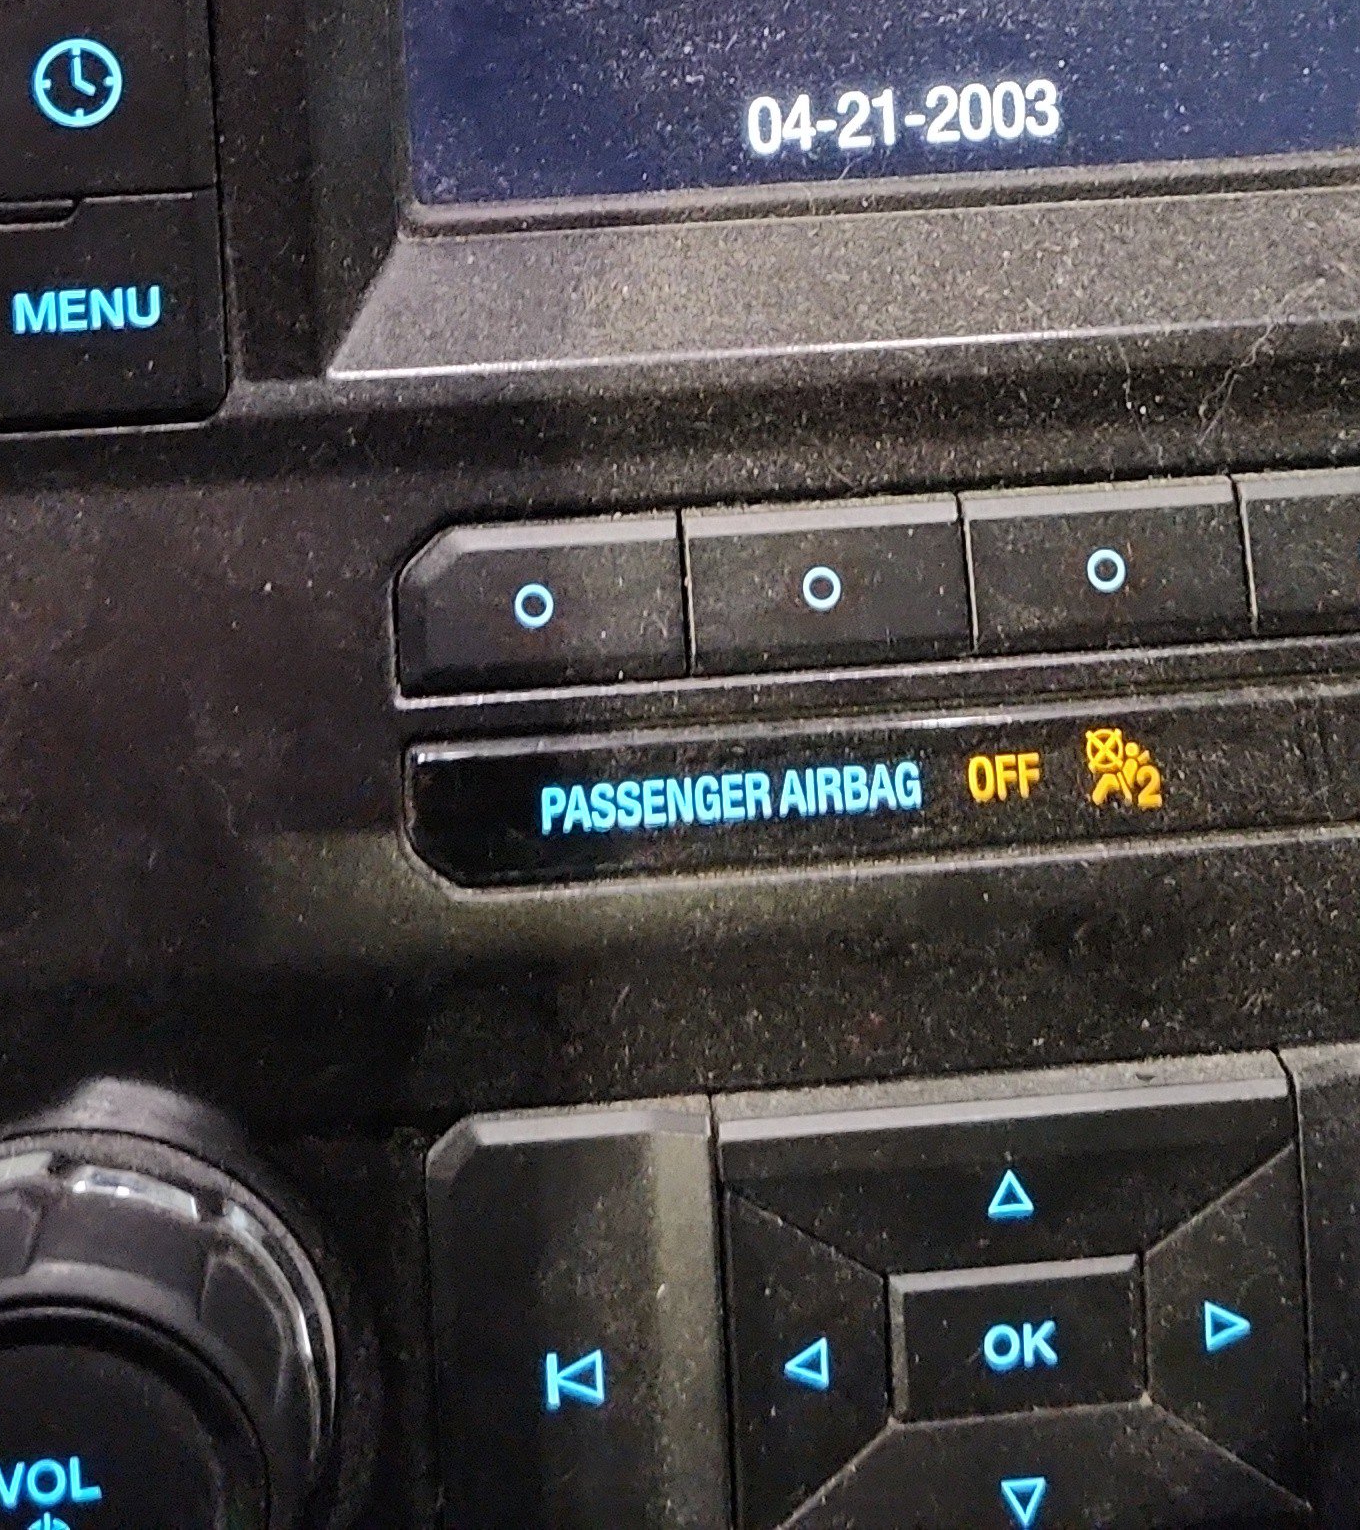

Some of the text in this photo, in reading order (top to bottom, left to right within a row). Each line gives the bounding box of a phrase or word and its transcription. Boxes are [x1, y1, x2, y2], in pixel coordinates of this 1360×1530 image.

[745, 77, 1064, 160] 04-21-2003
[11, 284, 162, 336] MENU
[540, 751, 1042, 836] PASSENGER AIRBAG OFF
[982, 1319, 1059, 1373] OK
